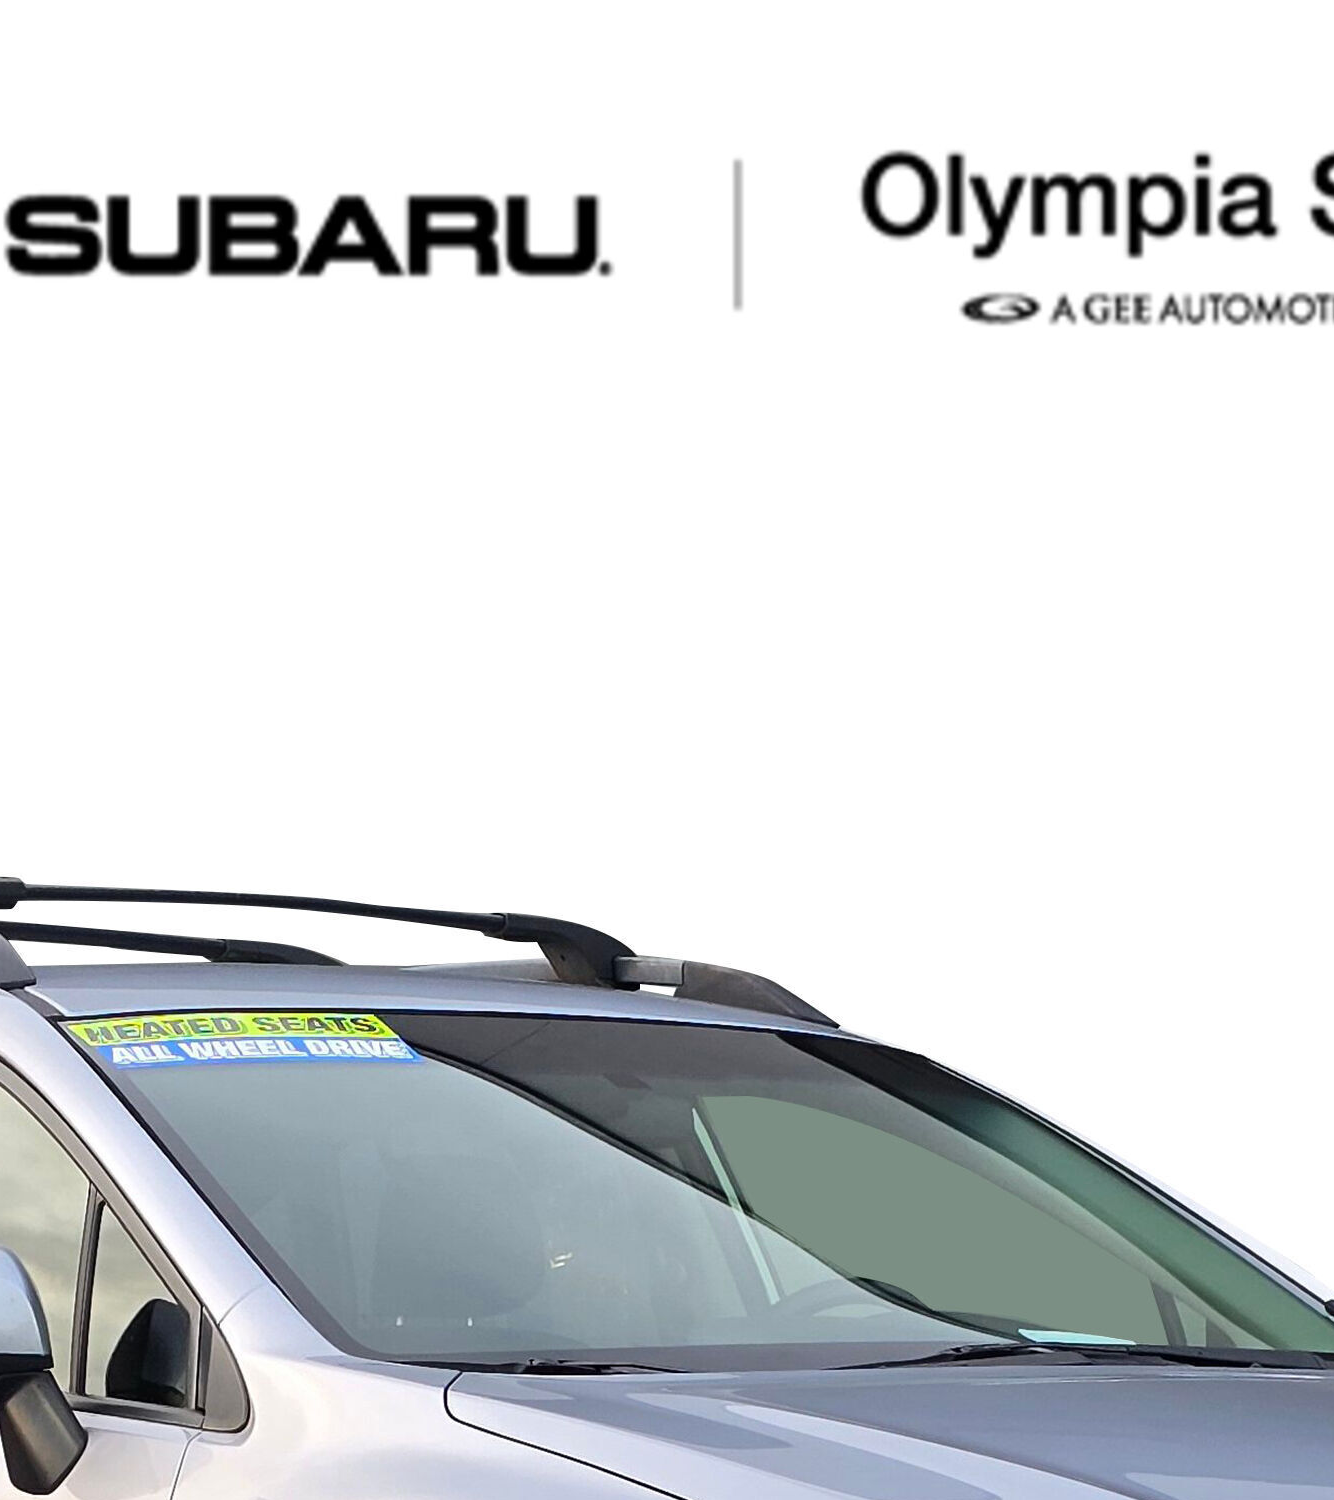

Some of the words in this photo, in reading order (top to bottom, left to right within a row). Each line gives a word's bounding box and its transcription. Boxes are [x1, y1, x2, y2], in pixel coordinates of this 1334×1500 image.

[84, 1017, 243, 1043] HEATED
[252, 1016, 382, 1034] SEATS
[112, 1045, 184, 1065] ALL
[178, 1039, 308, 1061] WHEEL
[304, 1039, 414, 1060] DRIVE
